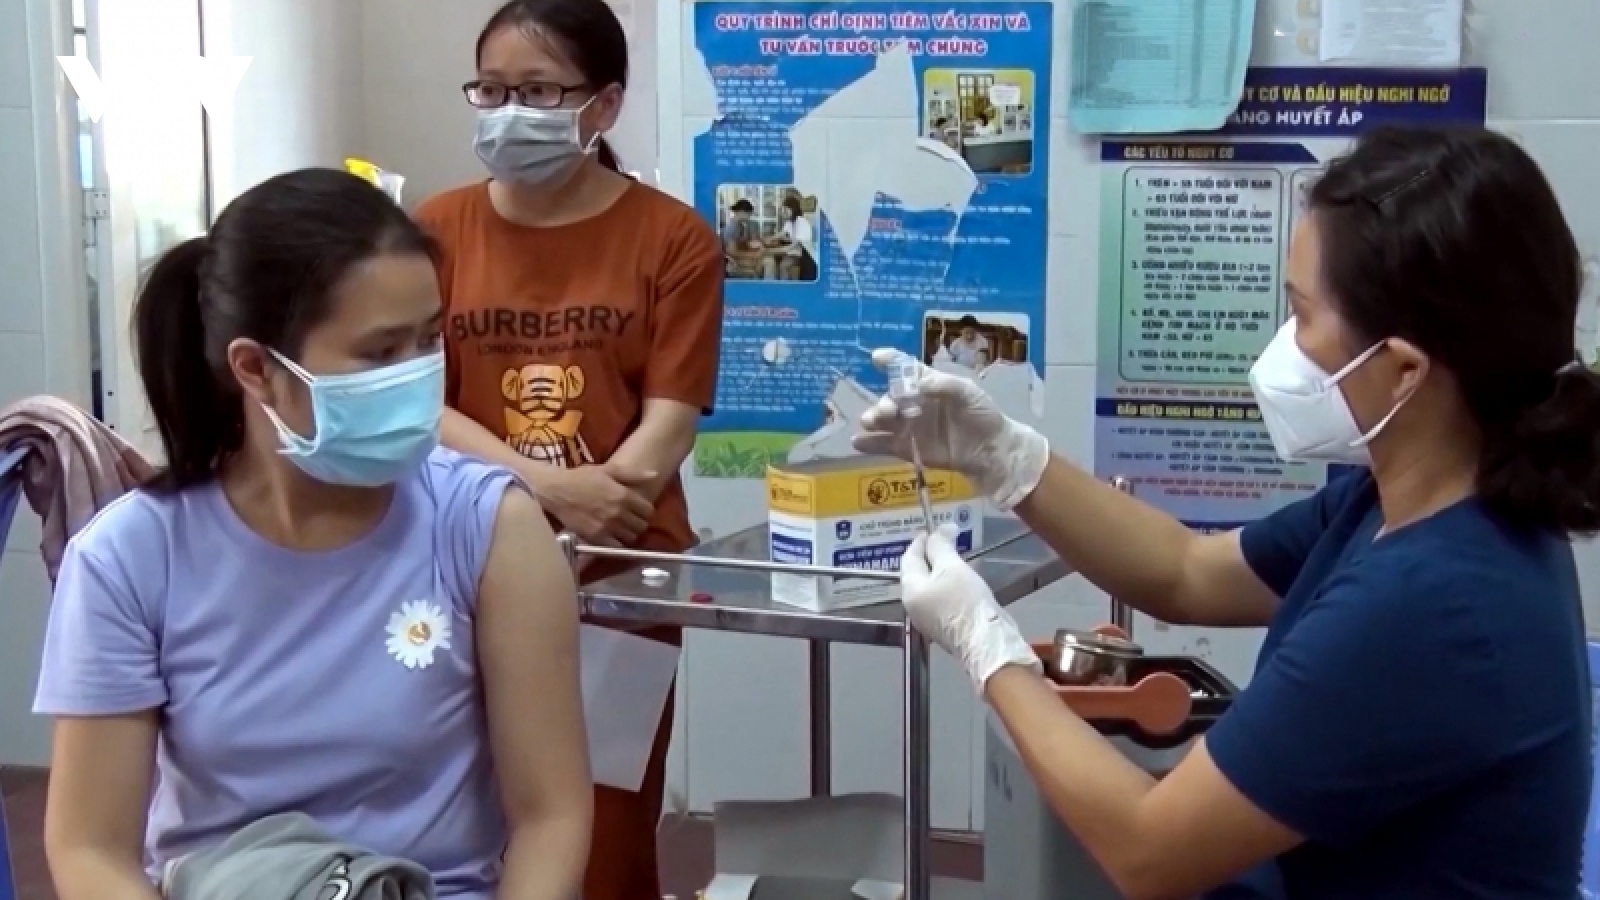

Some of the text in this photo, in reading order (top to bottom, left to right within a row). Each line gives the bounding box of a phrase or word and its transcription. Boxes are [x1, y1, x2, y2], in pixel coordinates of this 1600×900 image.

[716, 13, 751, 31] QUY
[754, 10, 806, 31] TRÌNH
[890, 10, 930, 31] TIÊM
[968, 13, 1002, 31] XIN
[1004, 10, 1031, 31] VÀ
[1282, 84, 1302, 103] VÀ
[1377, 86, 1415, 103] NGHI
[1276, 106, 1332, 126] HUYẾT
[1336, 106, 1365, 126] ÁP
[451, 305, 635, 341] BURBERRY
